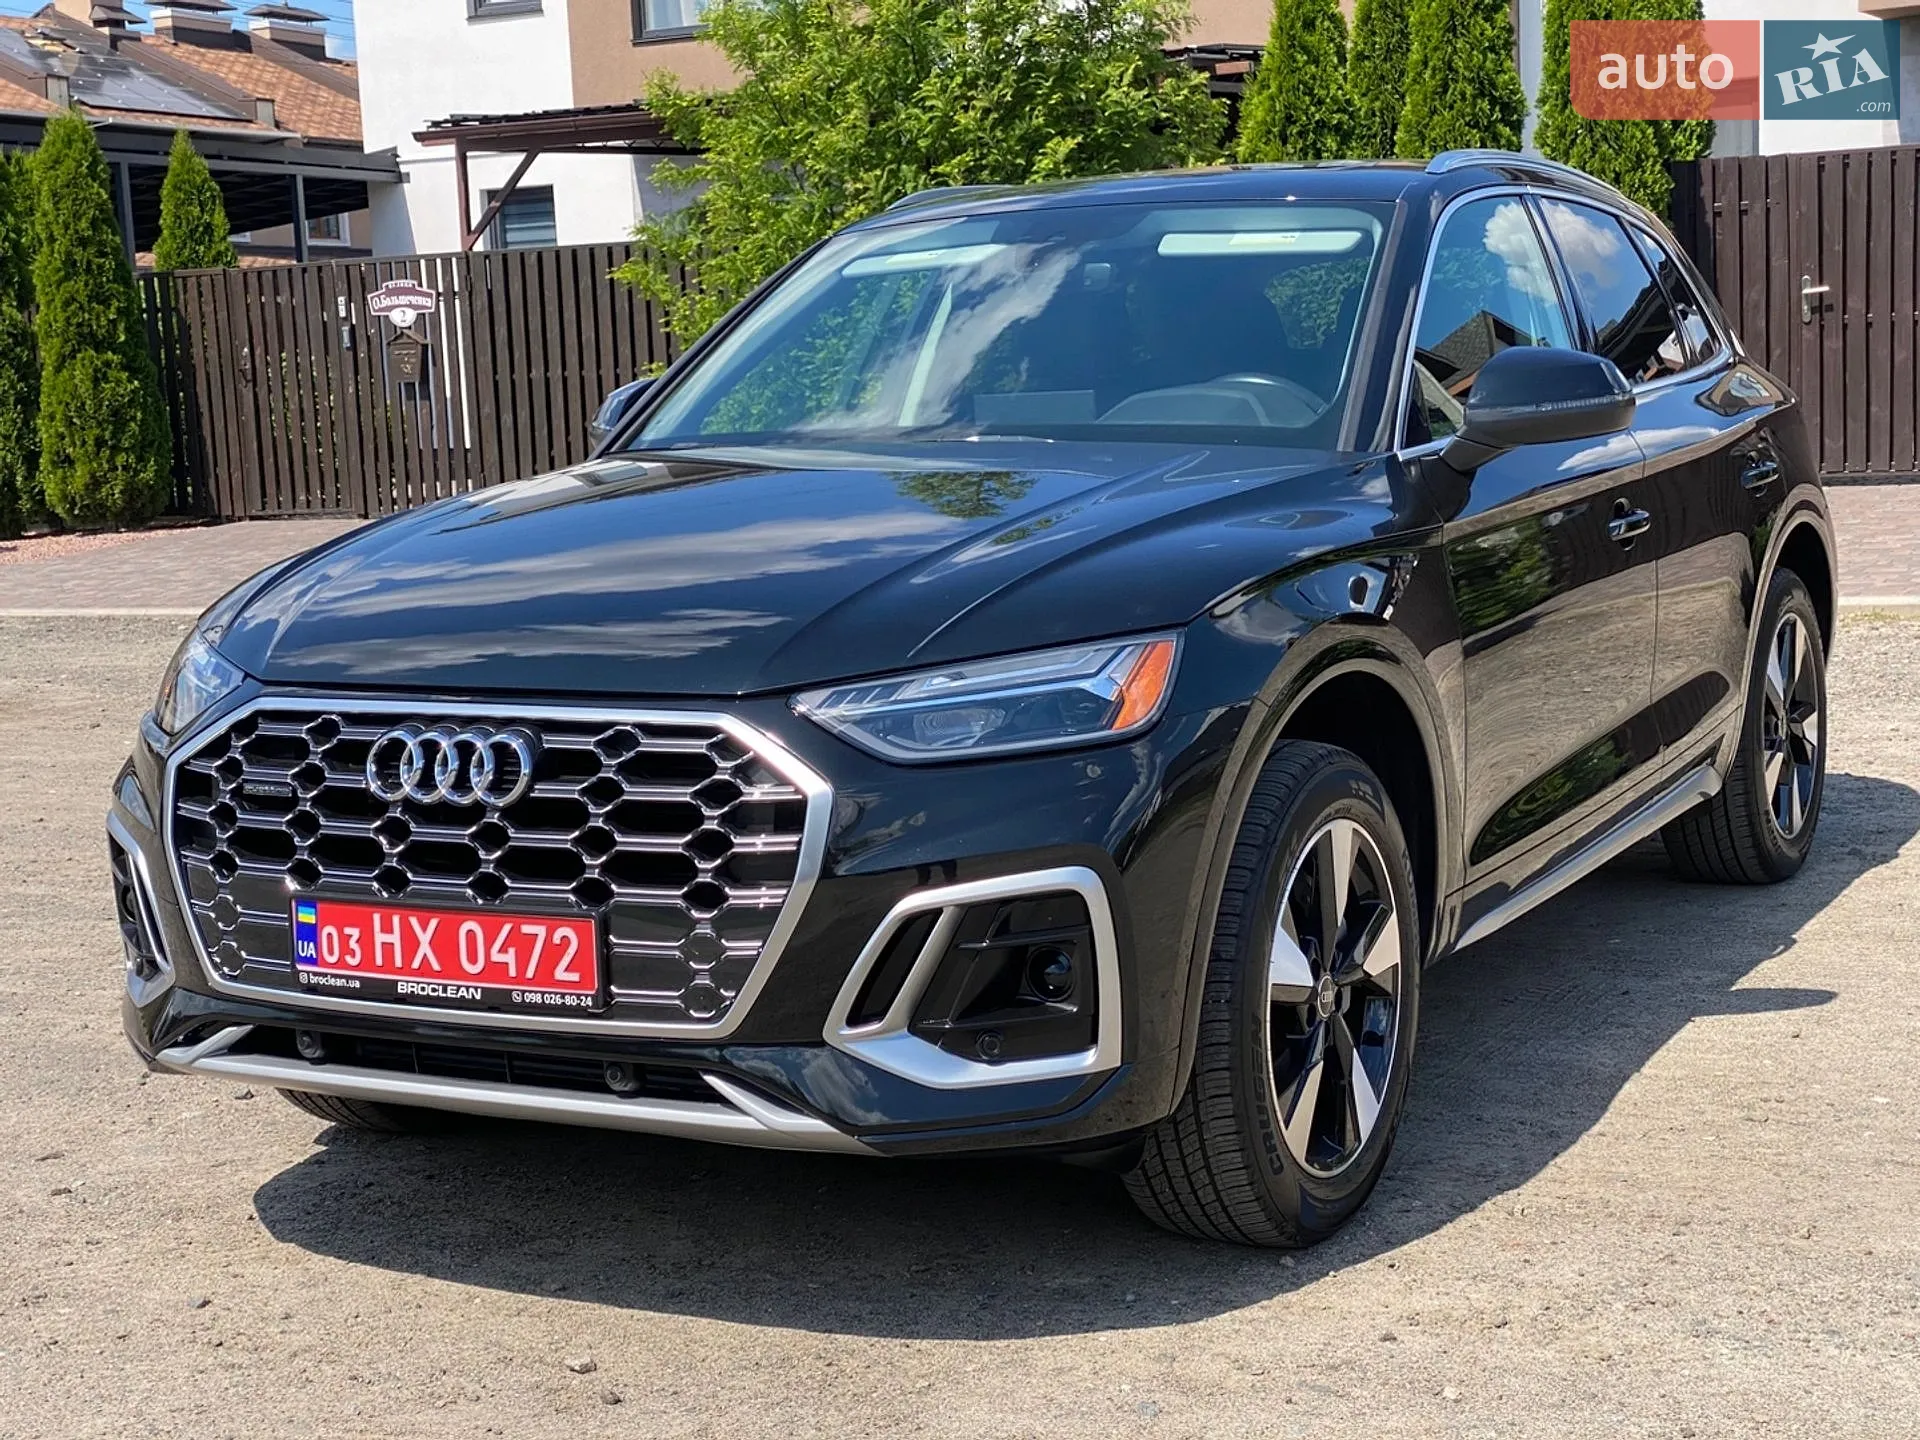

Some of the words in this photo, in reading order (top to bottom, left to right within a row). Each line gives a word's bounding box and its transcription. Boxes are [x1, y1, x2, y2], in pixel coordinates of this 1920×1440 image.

[298, 940, 317, 958] UA
[321, 925, 362, 967] 03
[373, 913, 442, 972] HX
[458, 920, 581, 982] 0472
[309, 973, 361, 989] broclean.ua
[397, 981, 482, 1000] BROCLEAN
[523, 992, 543, 1004] 098
[545, 994, 593, 1007] 026-80-24
